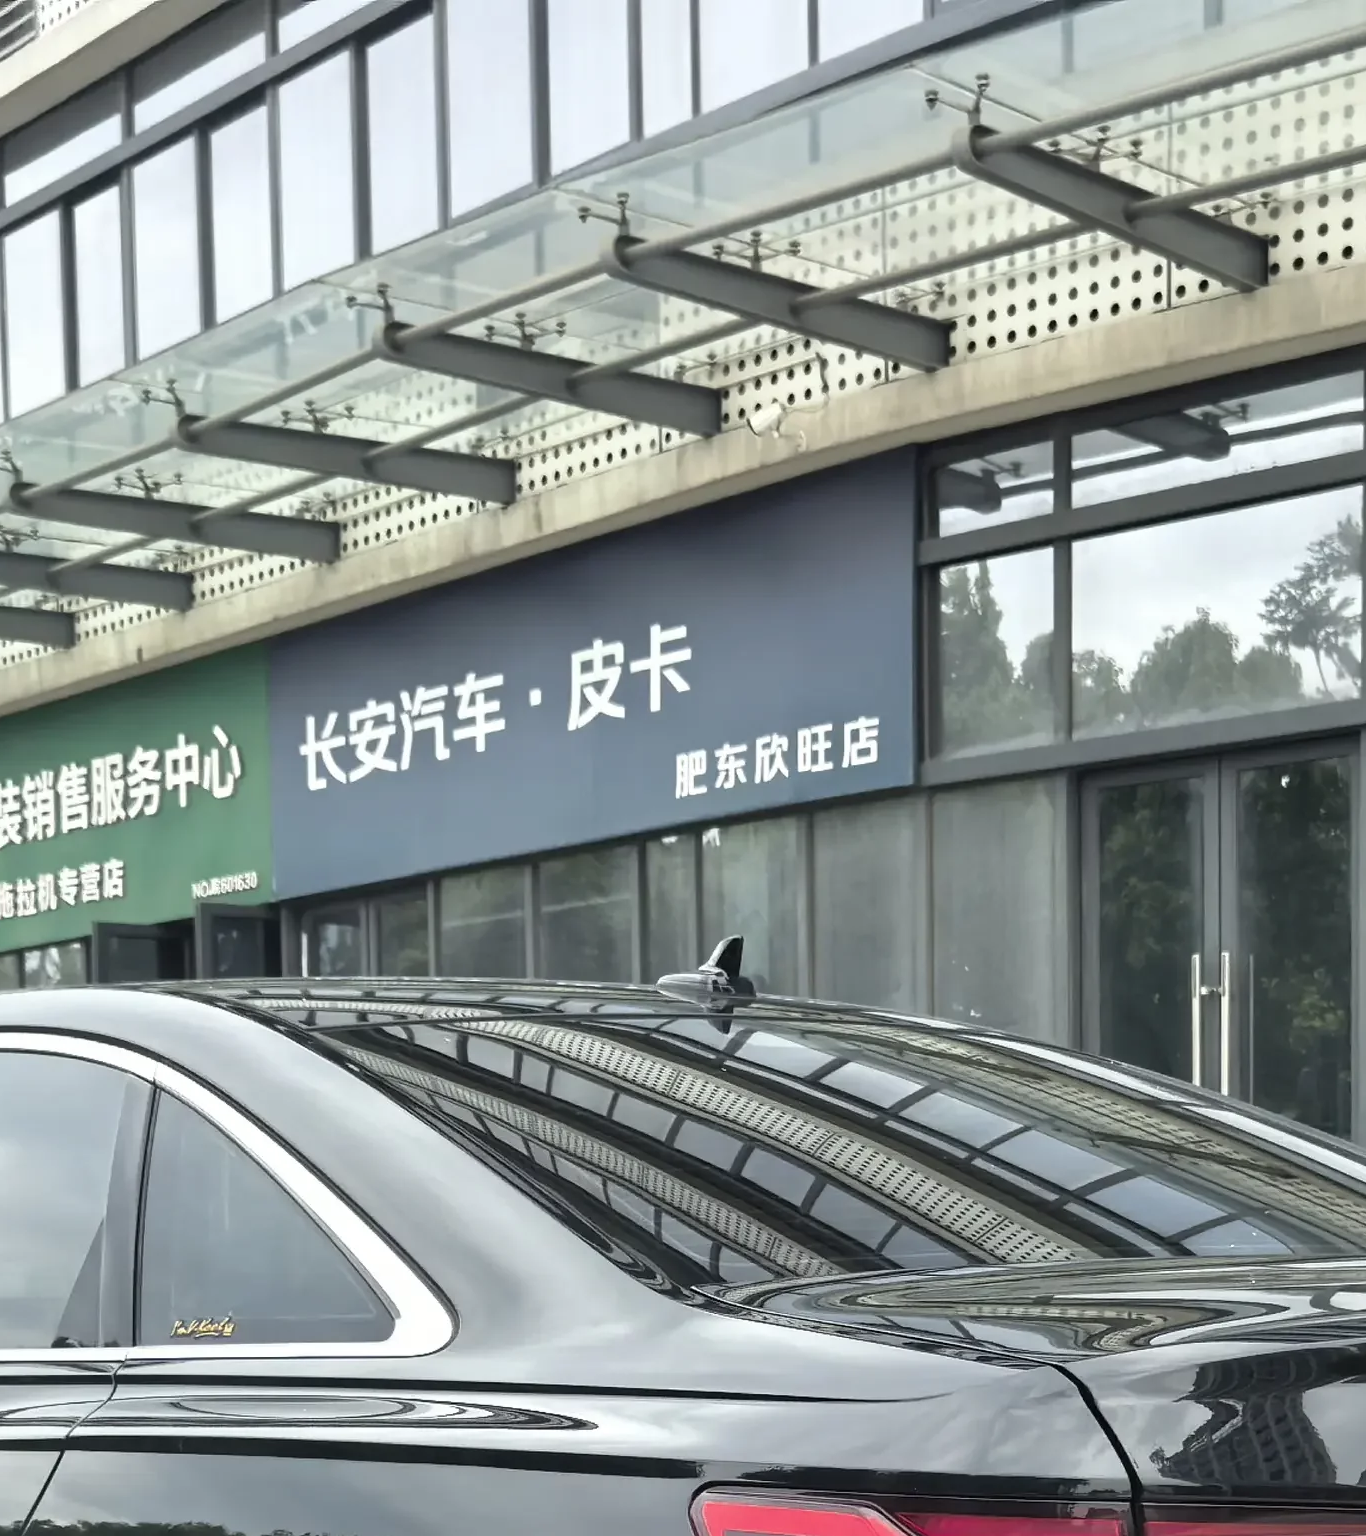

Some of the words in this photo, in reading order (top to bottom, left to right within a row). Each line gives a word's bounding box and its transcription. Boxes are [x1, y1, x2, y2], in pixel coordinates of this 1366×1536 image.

[675, 716, 880, 799] 肥东欣旺店
